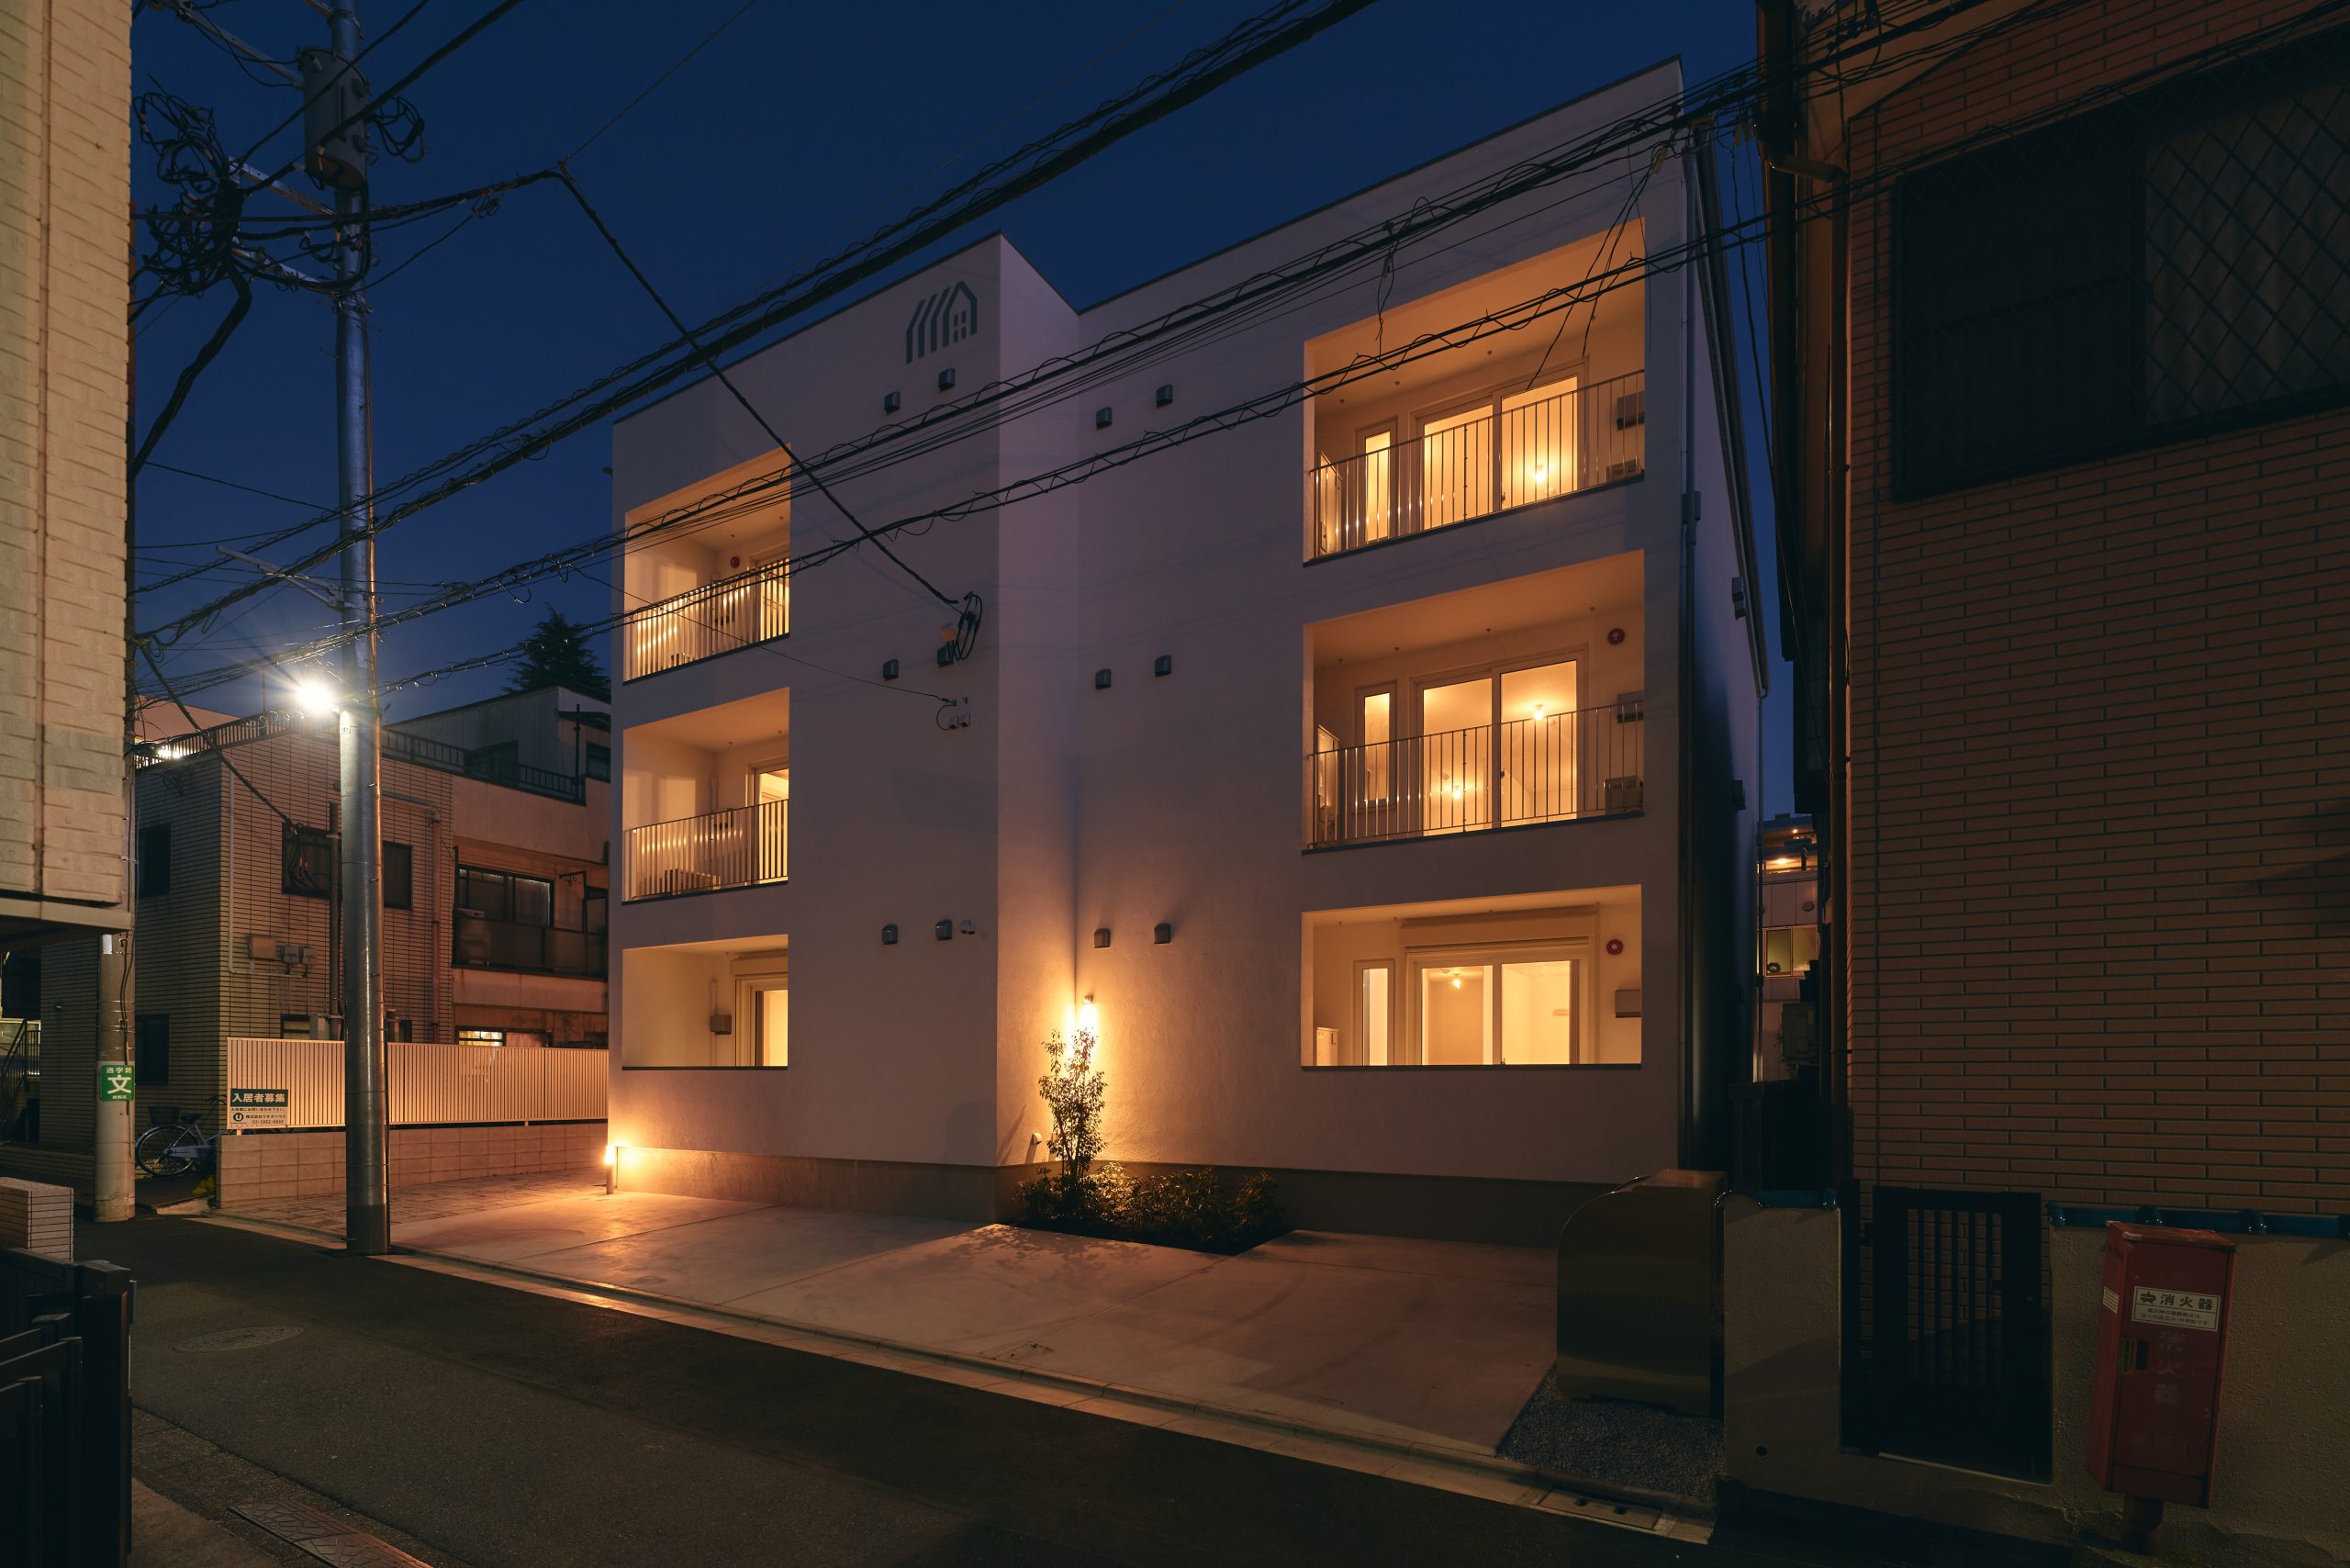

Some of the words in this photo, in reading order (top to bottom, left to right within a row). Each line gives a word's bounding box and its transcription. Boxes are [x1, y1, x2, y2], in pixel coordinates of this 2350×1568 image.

[107, 1074, 132, 1094] 文
[232, 1092, 285, 1103] 入居者募集
[2160, 1294, 2214, 1311] 消火器
